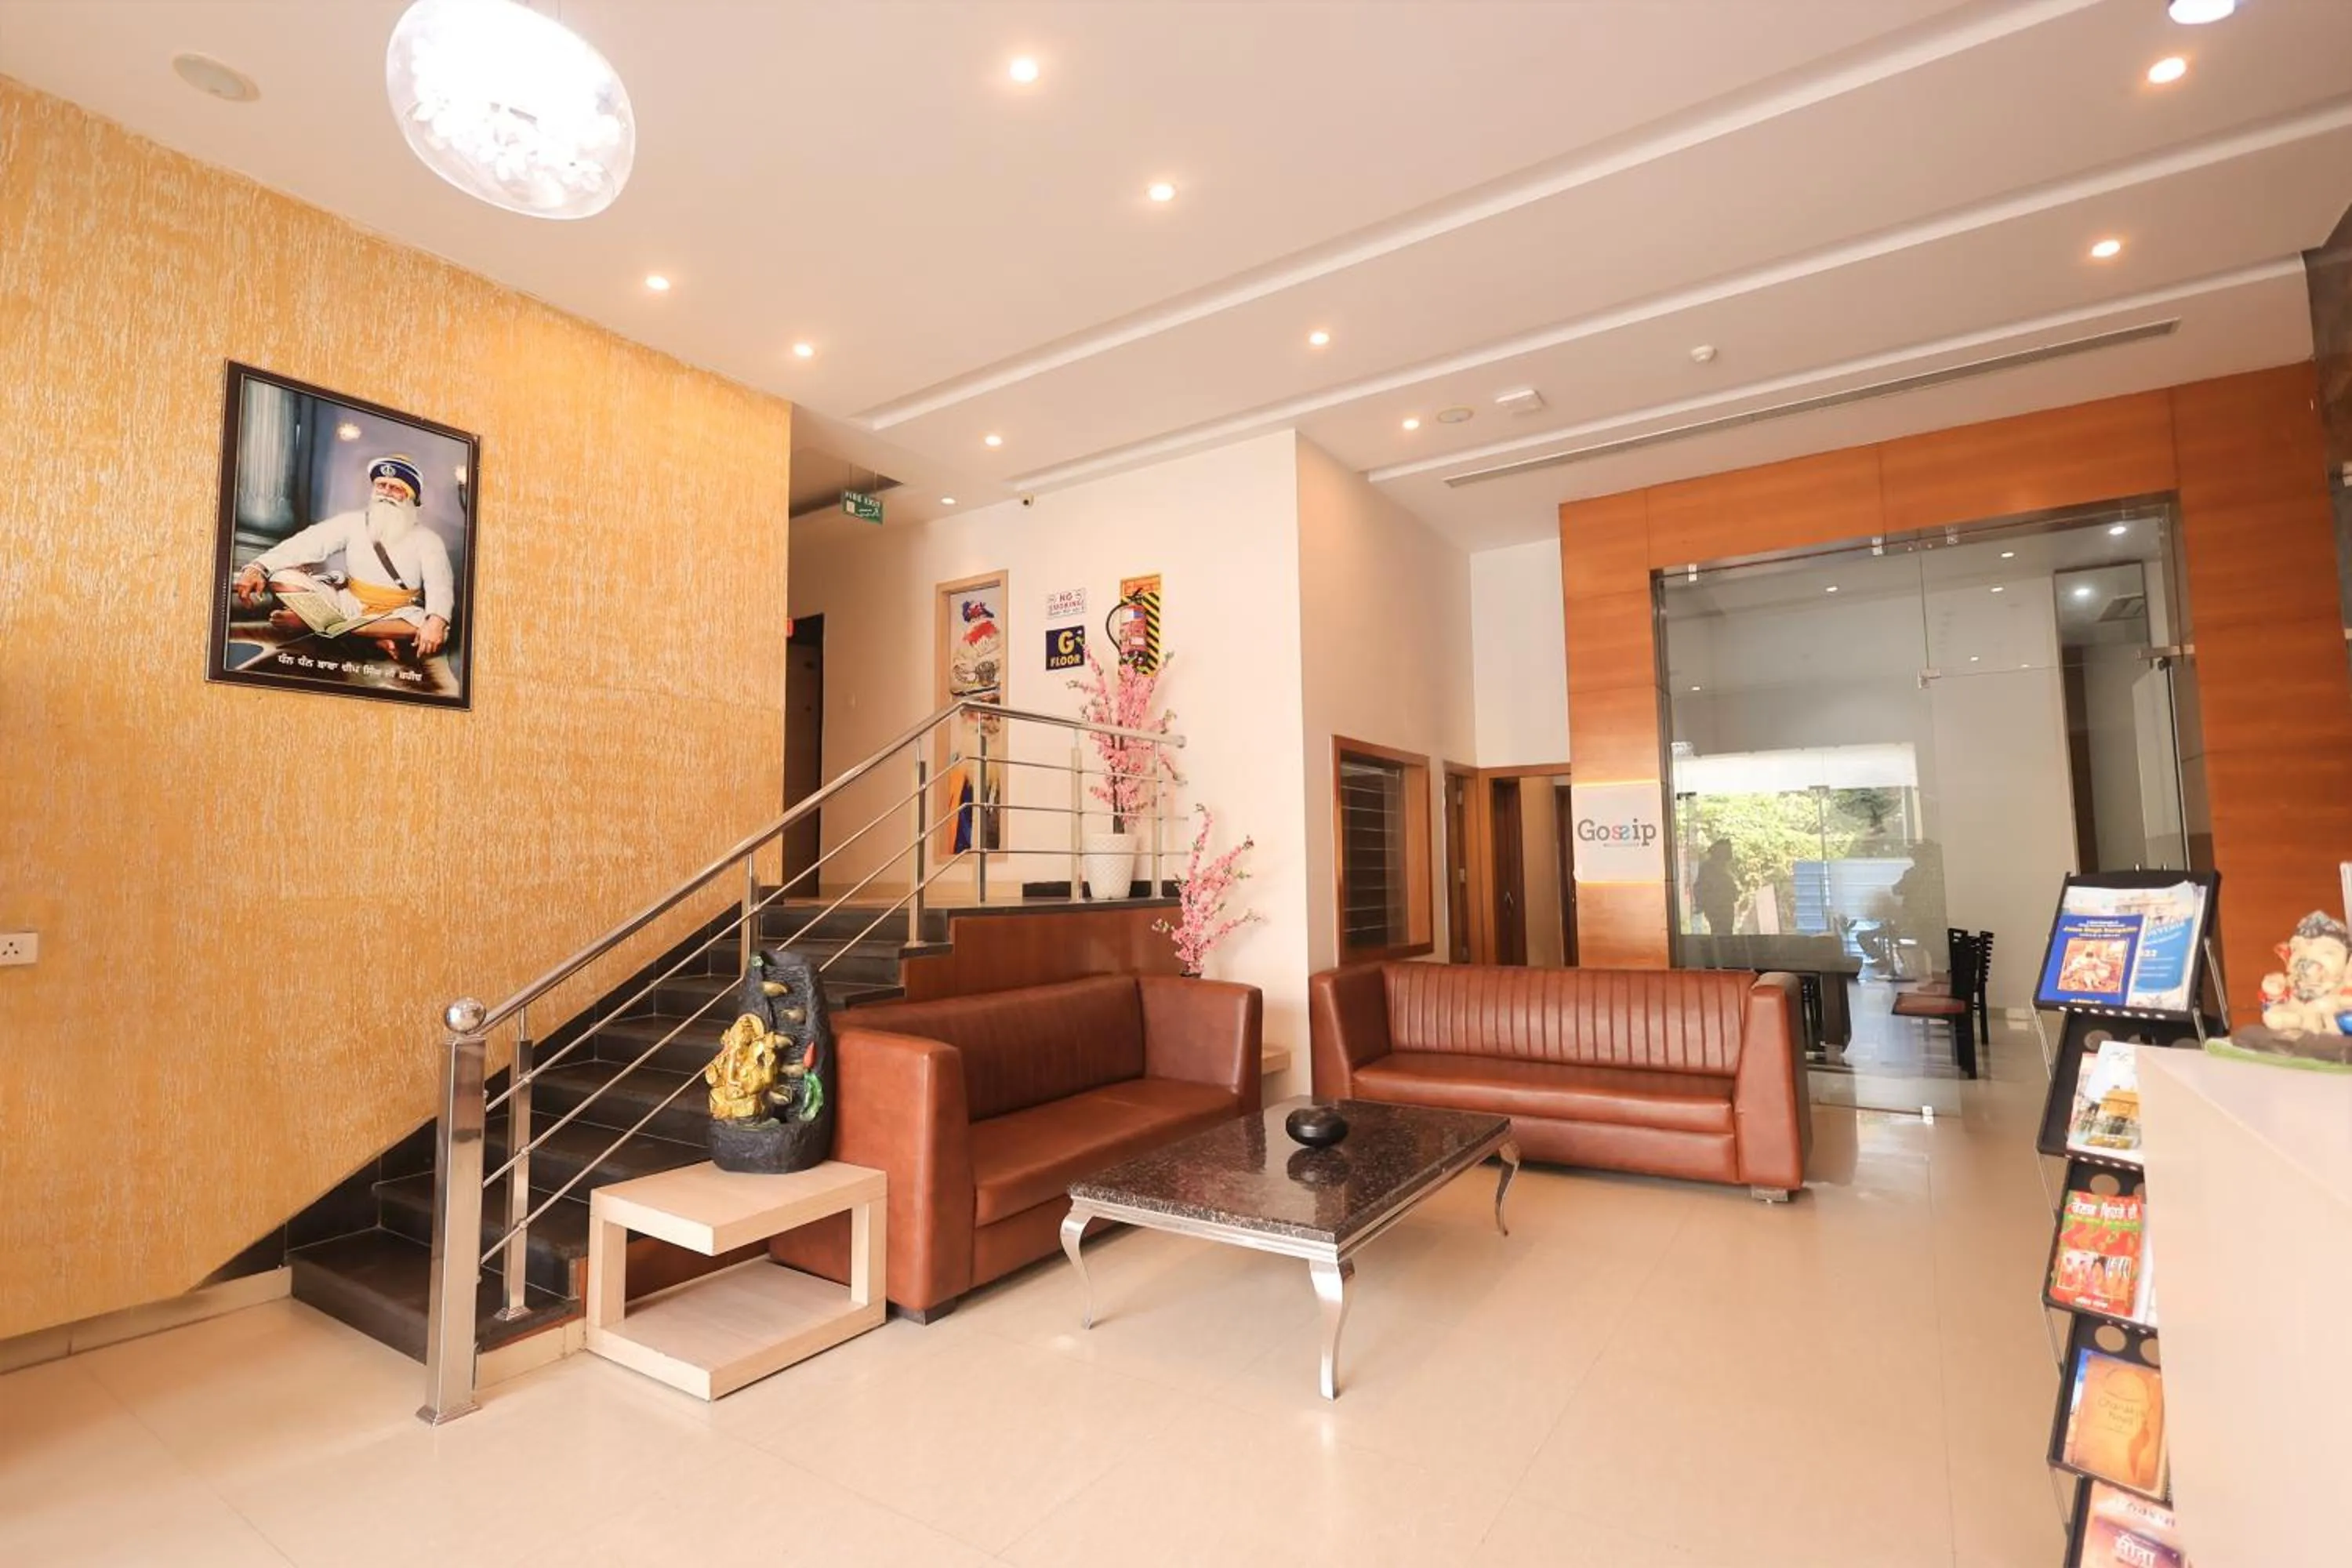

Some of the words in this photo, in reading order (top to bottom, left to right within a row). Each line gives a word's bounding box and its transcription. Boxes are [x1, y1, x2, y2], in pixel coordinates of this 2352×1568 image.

[1059, 592, 1073, 602] NO
[1058, 630, 1075, 654] G
[1050, 654, 1080, 666] FLOOR
[1577, 818, 1657, 846] Gossip
